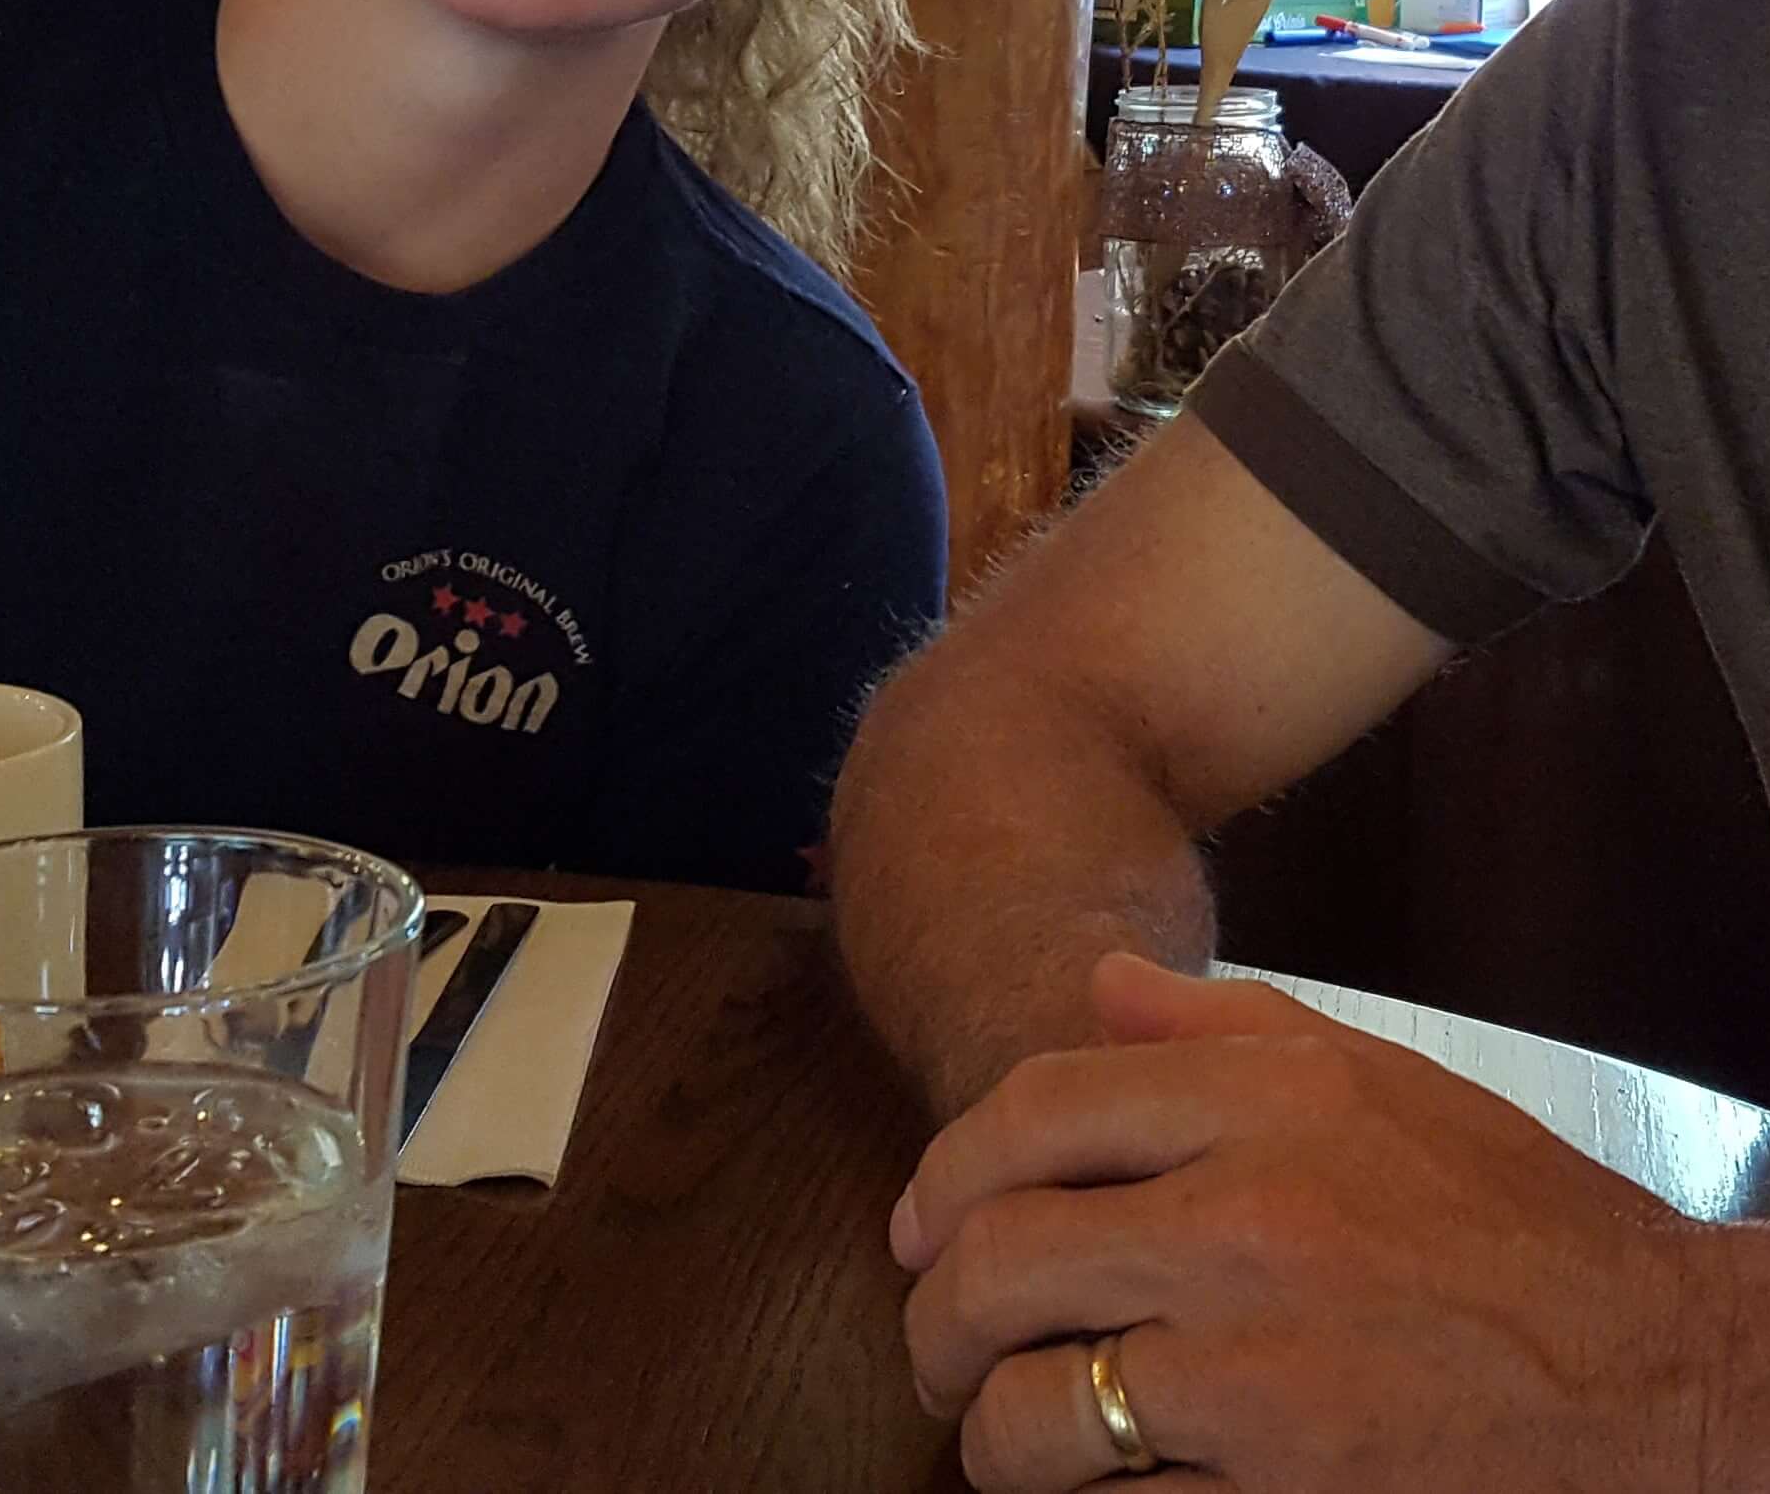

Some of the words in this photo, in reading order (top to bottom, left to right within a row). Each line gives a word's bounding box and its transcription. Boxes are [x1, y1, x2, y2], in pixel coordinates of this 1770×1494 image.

[459, 552, 558, 614] ORIGINAL
[556, 608, 594, 666] BREW
[349, 612, 560, 734] Orion
